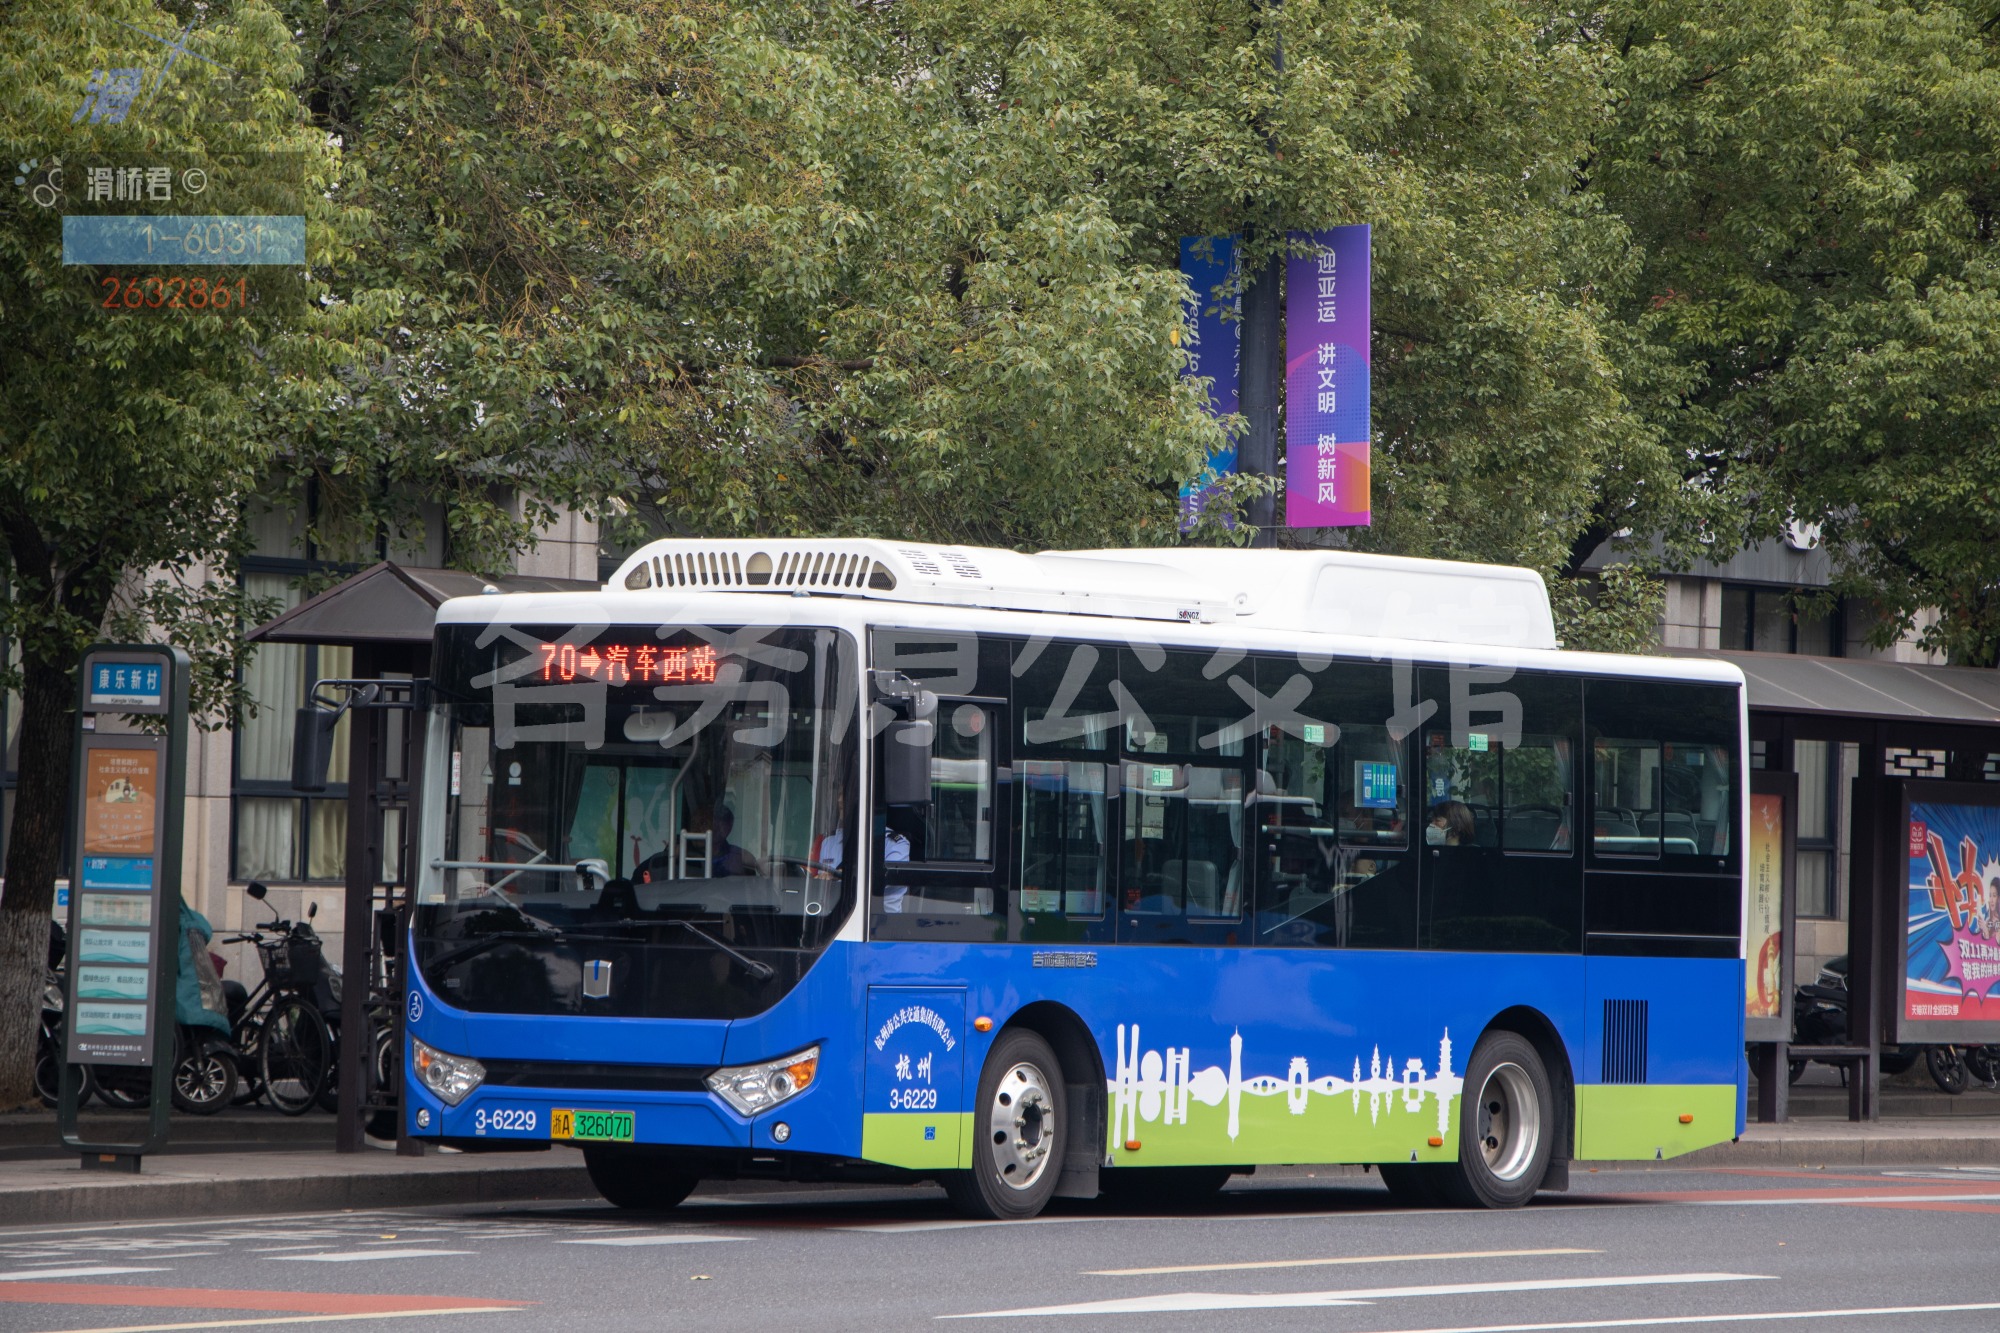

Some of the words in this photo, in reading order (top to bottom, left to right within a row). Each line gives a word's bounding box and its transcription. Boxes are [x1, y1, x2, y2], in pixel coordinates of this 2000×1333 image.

[1317, 249, 1336, 323] 迎亚运
[1317, 342, 1336, 414] 讲文明
[1317, 433, 1336, 505] 树新风
[1179, 610, 1200, 620] SONGZ
[540, 644, 577, 681] 70
[605, 645, 718, 682] 汽车西站
[98, 668, 158, 691] 康乐新村
[127, 697, 144, 705] Village
[874, 1005, 956, 1051] 杭州市公共交通集团有限公司
[895, 1052, 933, 1085] 杭州
[889, 1088, 937, 1109] 3-6229
[475, 1109, 537, 1131] 3-6229
[552, 1112, 632, 1138] 浙A32607D
